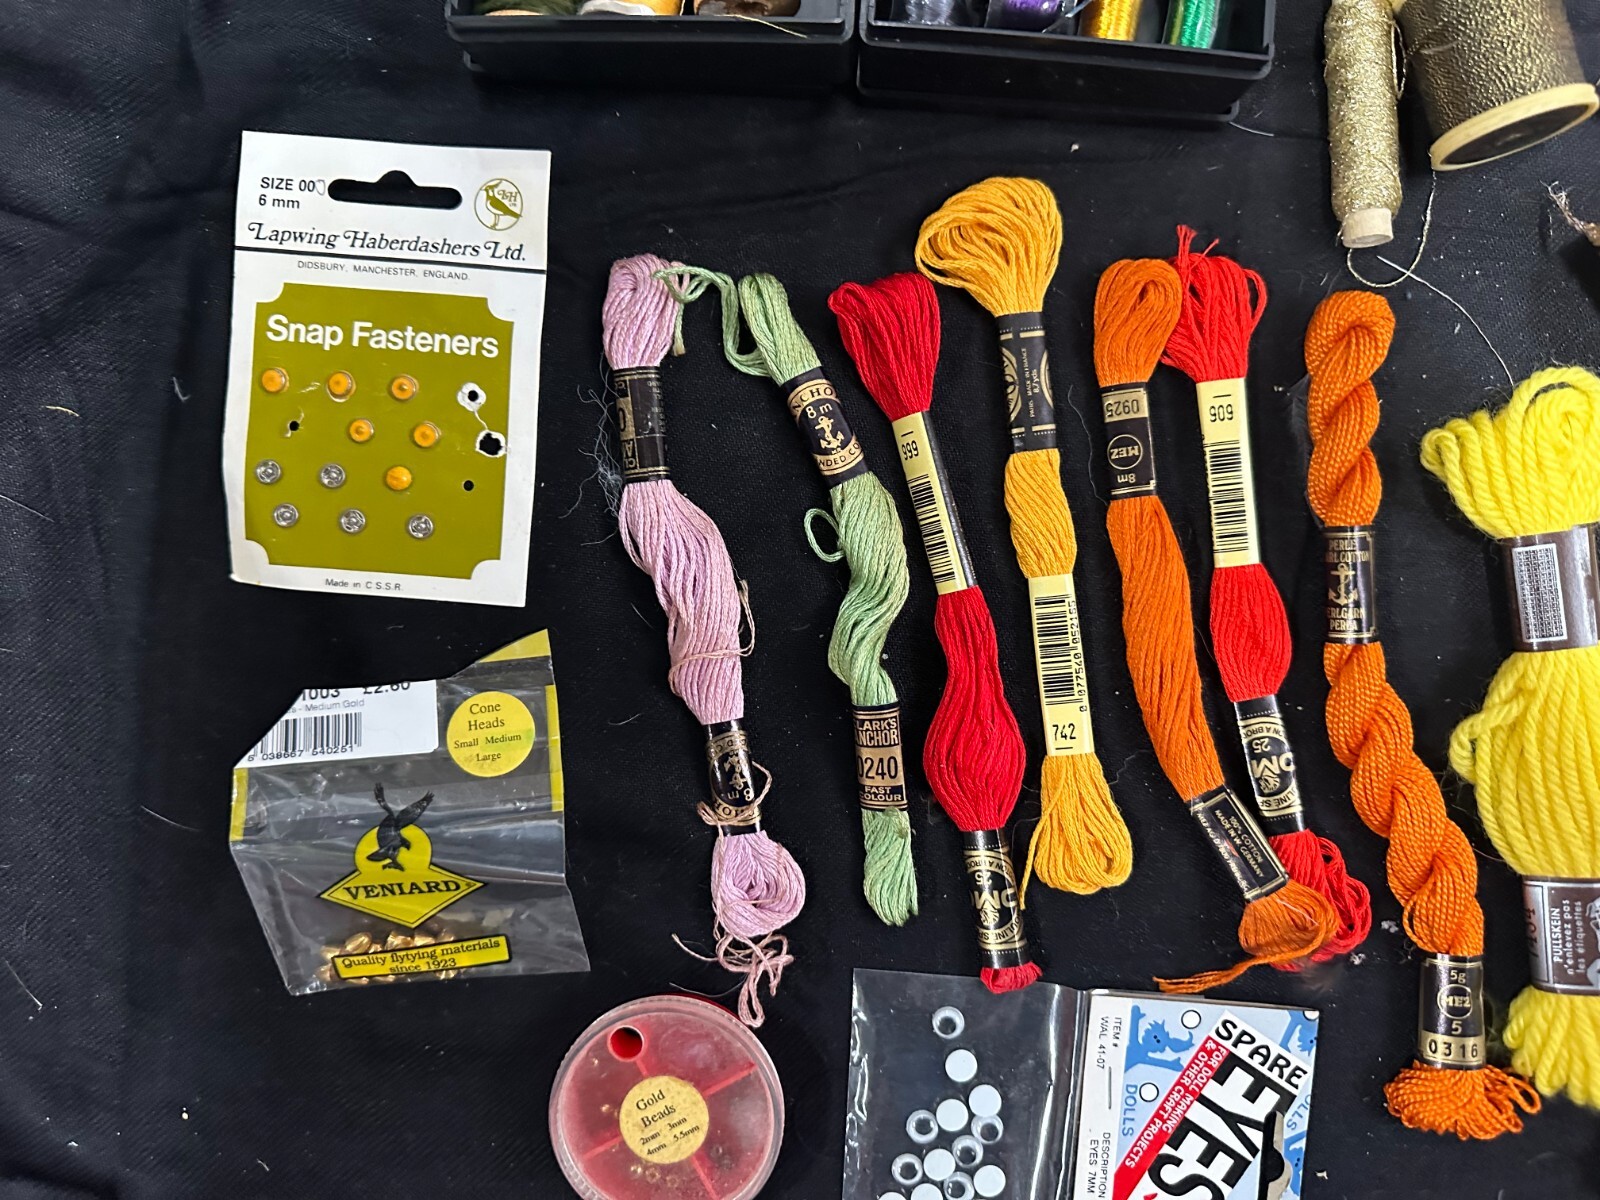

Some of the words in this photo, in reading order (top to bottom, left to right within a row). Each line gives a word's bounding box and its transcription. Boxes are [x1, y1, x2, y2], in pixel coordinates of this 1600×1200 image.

[260, 176, 294, 191] SIZE
[258, 193, 267, 206] 6
[271, 198, 300, 209] mm
[247, 221, 341, 249] Lapwing
[343, 229, 480, 257] Haberdashers
[483, 240, 526, 261] Ltd.
[266, 314, 344, 351] Snap
[351, 320, 499, 359] Fasteners
[1110, 445, 1140, 460] MEZ
[325, 578, 349, 589] Made
[304, 701, 341, 712] Medium
[343, 698, 365, 709] Gold
[469, 701, 502, 716] Cone
[467, 716, 506, 732] Heads
[1051, 722, 1077, 741] 742
[453, 737, 480, 750] Small
[484, 732, 523, 746] Medium
[1251, 738, 1271, 753] 25
[475, 751, 502, 763] Large
[864, 786, 892, 794] FAST
[1214, 809, 1230, 829] MADE
[1227, 826, 1236, 838] IN
[1240, 846, 1264, 878] GERMANY
[1241, 834, 1264, 863] COTTON
[343, 879, 461, 901] VENIARD
[969, 887, 1018, 911] DM
[1550, 907, 1563, 963] PULLSKEIN
[341, 953, 387, 969] Quality
[390, 948, 437, 964] flytying
[440, 938, 501, 956] materials
[389, 961, 422, 974] since
[425, 957, 457, 970] 1923
[1450, 969, 1466, 984] 5g
[1445, 995, 1471, 1007] MEZ
[1099, 1016, 1109, 1040] WAL
[1113, 1017, 1122, 1039] ITEM
[1451, 1020, 1463, 1035] 5
[1096, 1043, 1106, 1070] 41-07
[1205, 1040, 1217, 1051] &
[1207, 1045, 1229, 1068] FOR
[1214, 1018, 1308, 1090] SPARE
[1179, 1052, 1209, 1086] OTHER
[1188, 1065, 1214, 1095] DOLL
[635, 1089, 666, 1112] Gold
[1121, 1084, 1138, 1137] DOLLS
[1157, 1085, 1187, 1120] CRAFT
[640, 1103, 677, 1128] Beads
[1162, 1094, 1194, 1135] MAKING
[640, 1130, 661, 1146] 2mm
[667, 1116, 687, 1131] 3mm
[1147, 1053, 1298, 1200] EYES
[646, 1142, 667, 1157] 4mm
[1088, 1139, 1100, 1167] EYES
[1124, 1118, 1163, 1169] PROJECTS
[1098, 1132, 1111, 1199] DESCRIPTION
[1086, 1172, 1097, 1195] 7MM
